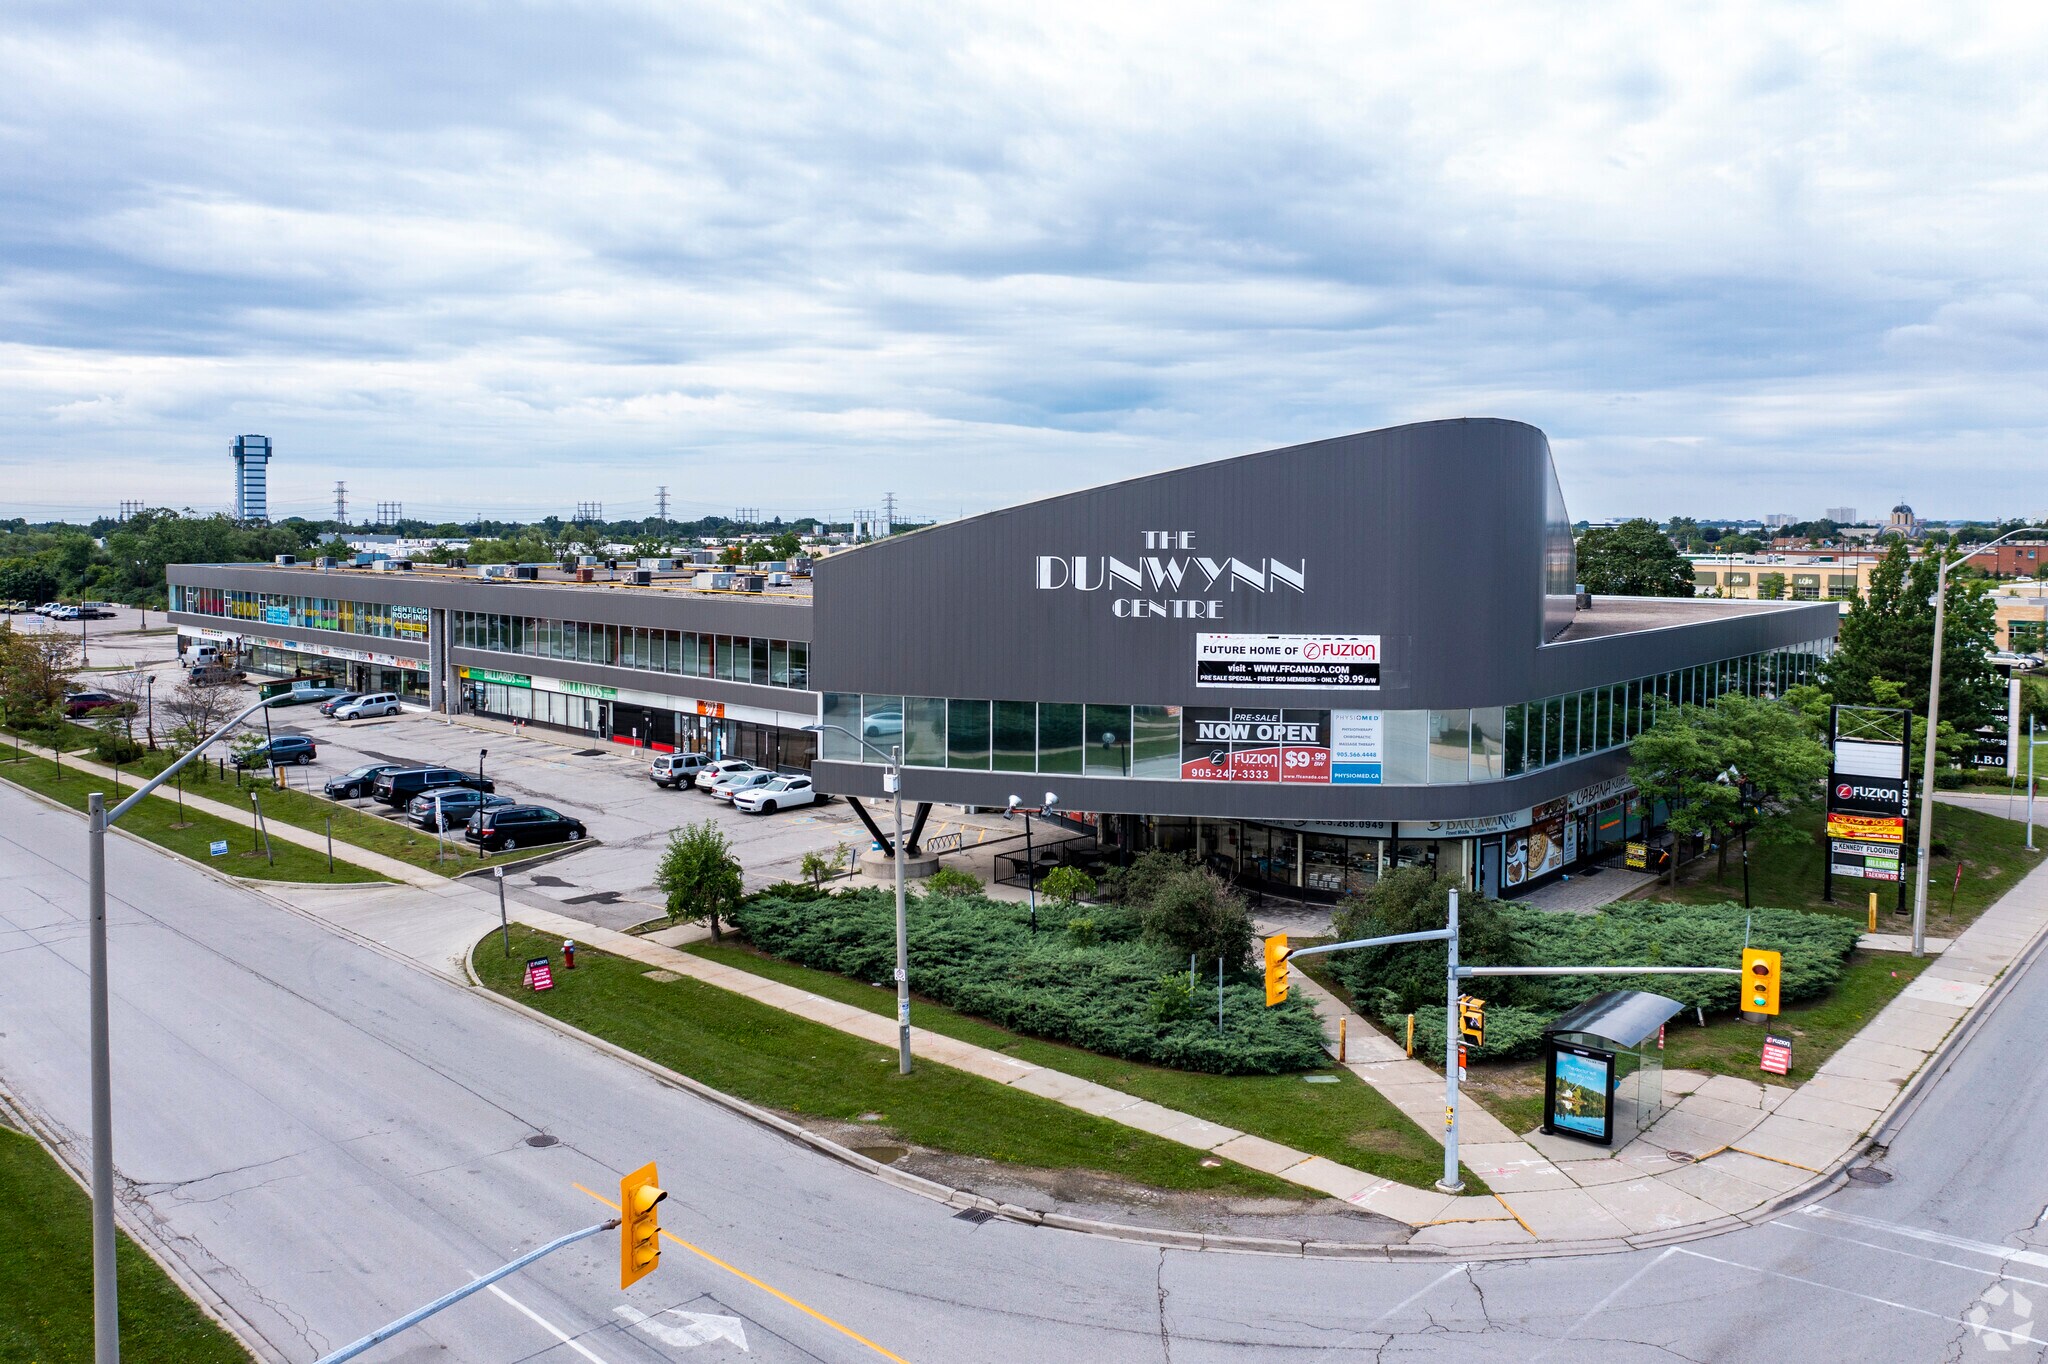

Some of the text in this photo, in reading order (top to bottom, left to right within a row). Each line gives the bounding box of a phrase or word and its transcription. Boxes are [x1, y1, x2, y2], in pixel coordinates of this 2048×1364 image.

[1141, 530, 1196, 550] THE
[1036, 555, 1305, 593] DUNWYNN
[1112, 598, 1224, 619] CENTRE
[1203, 645, 1246, 655] FUTURE
[1249, 646, 1281, 655] HOME
[1284, 646, 1299, 656] OF
[1227, 664, 1246, 672] visit
[1253, 664, 1350, 674] WWW.FFCANADA.COM
[484, 670, 516, 684] BILLIARDS
[1338, 674, 1364, 684] $9.99
[560, 680, 603, 698] BILLIARDS
[1234, 713, 1278, 722] PRE-SALE
[1199, 724, 1317, 741] NOW OPEN
[1191, 768, 1269, 779] 905-247-3333
[1901, 780, 1909, 816] 1590
[1838, 843, 1864, 851] KENNEDY
[1866, 846, 1899, 855] FLOORING
[1867, 860, 1898, 869] BILLIARDS
